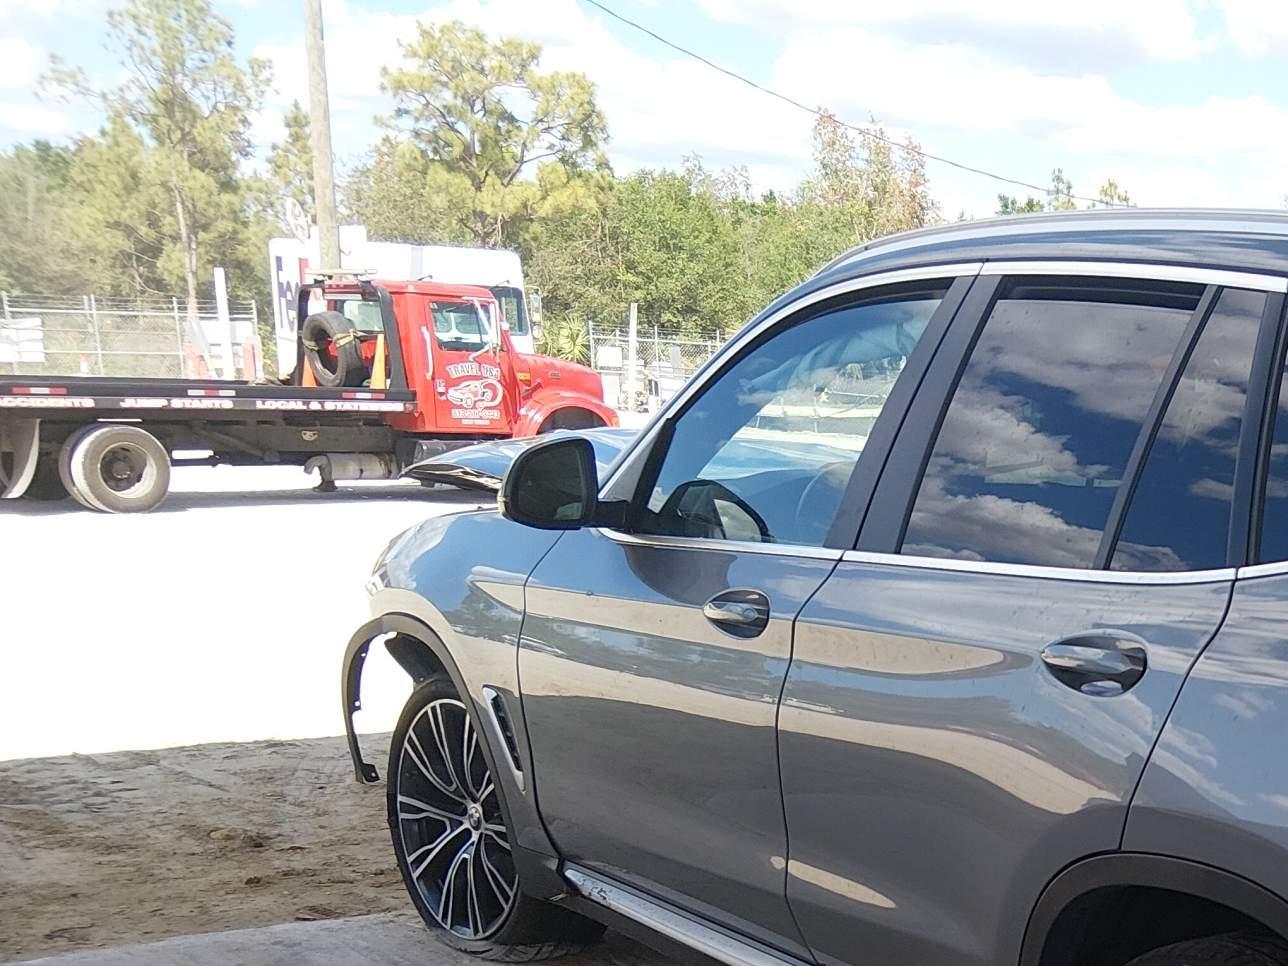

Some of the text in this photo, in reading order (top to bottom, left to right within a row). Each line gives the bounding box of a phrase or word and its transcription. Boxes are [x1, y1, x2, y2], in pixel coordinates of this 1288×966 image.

[446, 362, 481, 379] TRAVEL
[170, 398, 233, 408] STARTS
[256, 400, 307, 410] LOCAL
